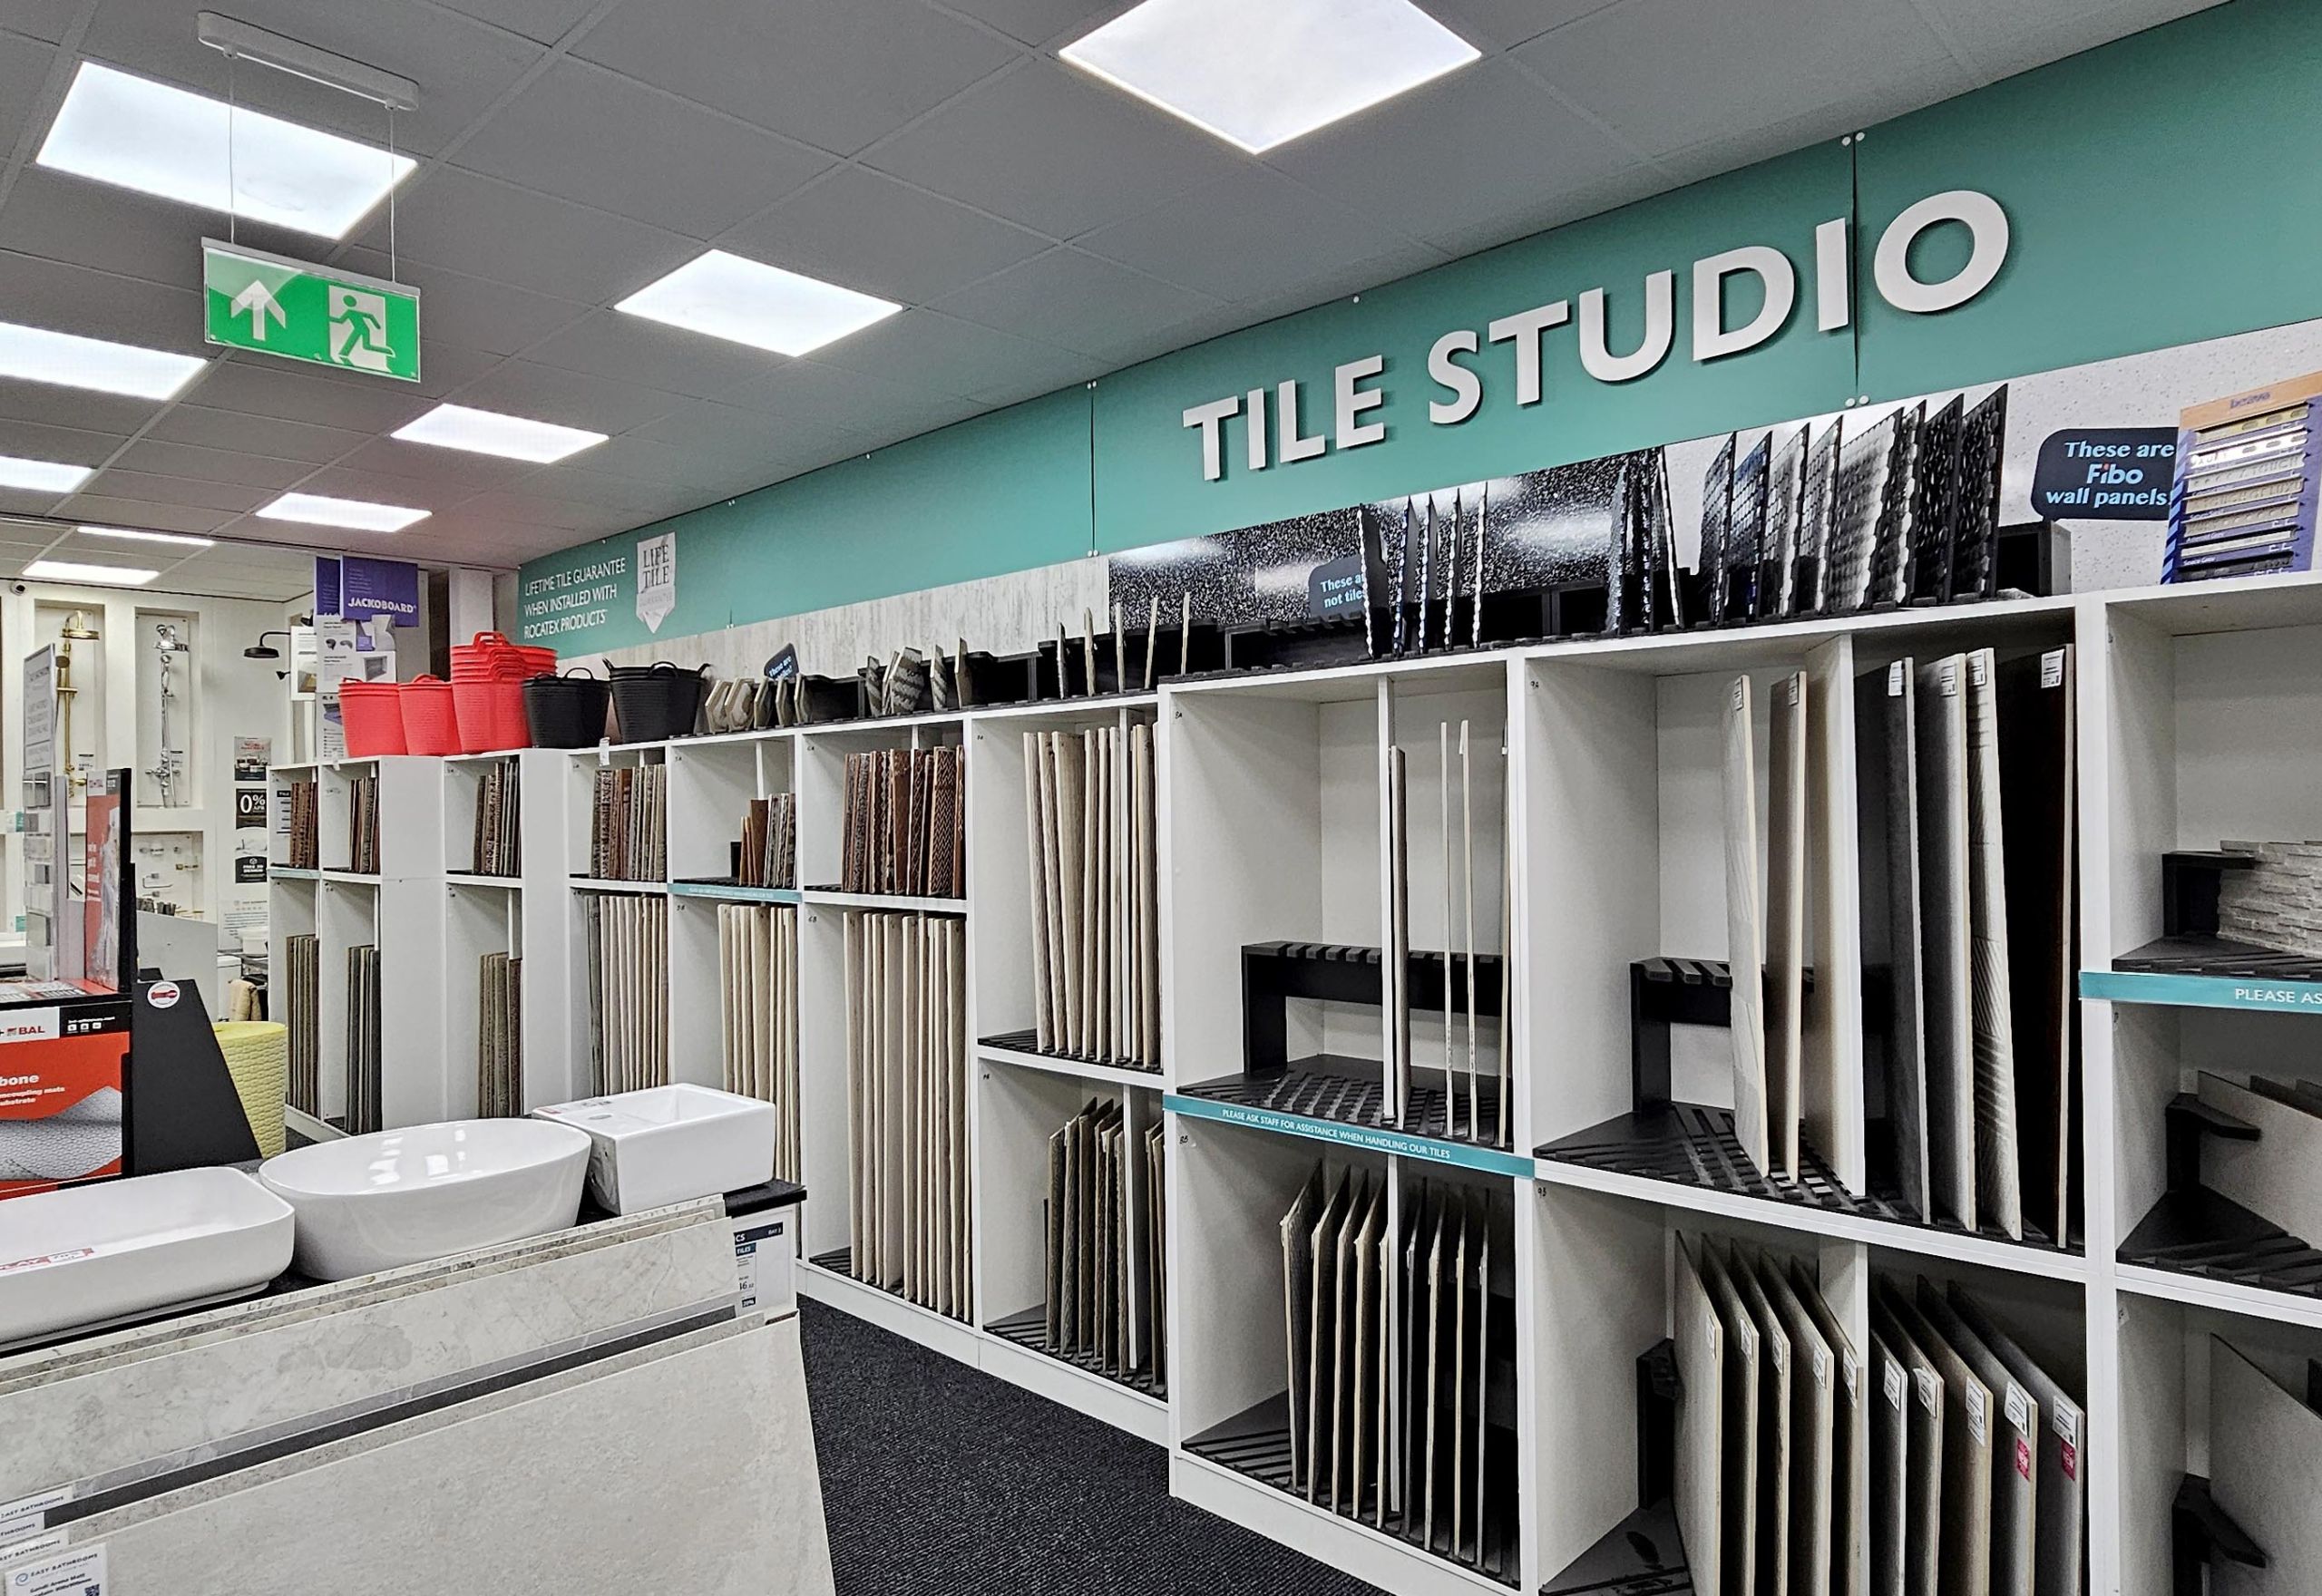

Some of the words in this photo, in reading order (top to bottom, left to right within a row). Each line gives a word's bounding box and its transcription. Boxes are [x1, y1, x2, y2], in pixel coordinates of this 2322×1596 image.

[1182, 354, 1387, 481] TILE
[1429, 189, 2011, 425] STUDIO
[2064, 440, 2131, 458] These
[2136, 443, 2175, 458] are
[2086, 462, 2143, 484] Fibo
[2045, 488, 2088, 504] wall
[643, 544, 669, 569] LIFE
[524, 575, 555, 597] LIFETIME
[555, 570, 572, 588] TILE
[572, 557, 627, 585] GUARANTEE
[643, 565, 669, 589] TILE
[1321, 576, 1353, 592] These
[347, 597, 415, 614] JACKOBOARD
[523, 598, 551, 618] WHEN
[550, 589, 590, 613] INSTALLED
[591, 583, 618, 603] WITH
[1324, 593, 1343, 608] not
[523, 618, 560, 639] ROCATEX
[560, 608, 607, 633] PRODUCTS
[239, 793, 266, 813] 0%
[2234, 988, 2296, 1003] PLEASE
[2300, 992, 2322, 1005] AS
[18, 1026, 45, 1035] BAL
[1222, 1109, 1245, 1121] PLEASE
[1245, 1114, 1260, 1124] ASK
[1260, 1116, 1279, 1127] STAFF
[1280, 1120, 1295, 1130] FOR
[1295, 1122, 1338, 1138] ASSISTANCE
[1339, 1130, 1363, 1143] WHEN
[1364, 1135, 1407, 1151] HANDLING
[1409, 1143, 1429, 1154] OUR
[1429, 1146, 1451, 1159] TILES
[20, 1495, 63, 1513] BATHROOMS
[15, 1539, 61, 1557] BATHROOMS
[30, 1567, 50, 1577] EASY
[52, 1552, 98, 1572] BATHROOMS
